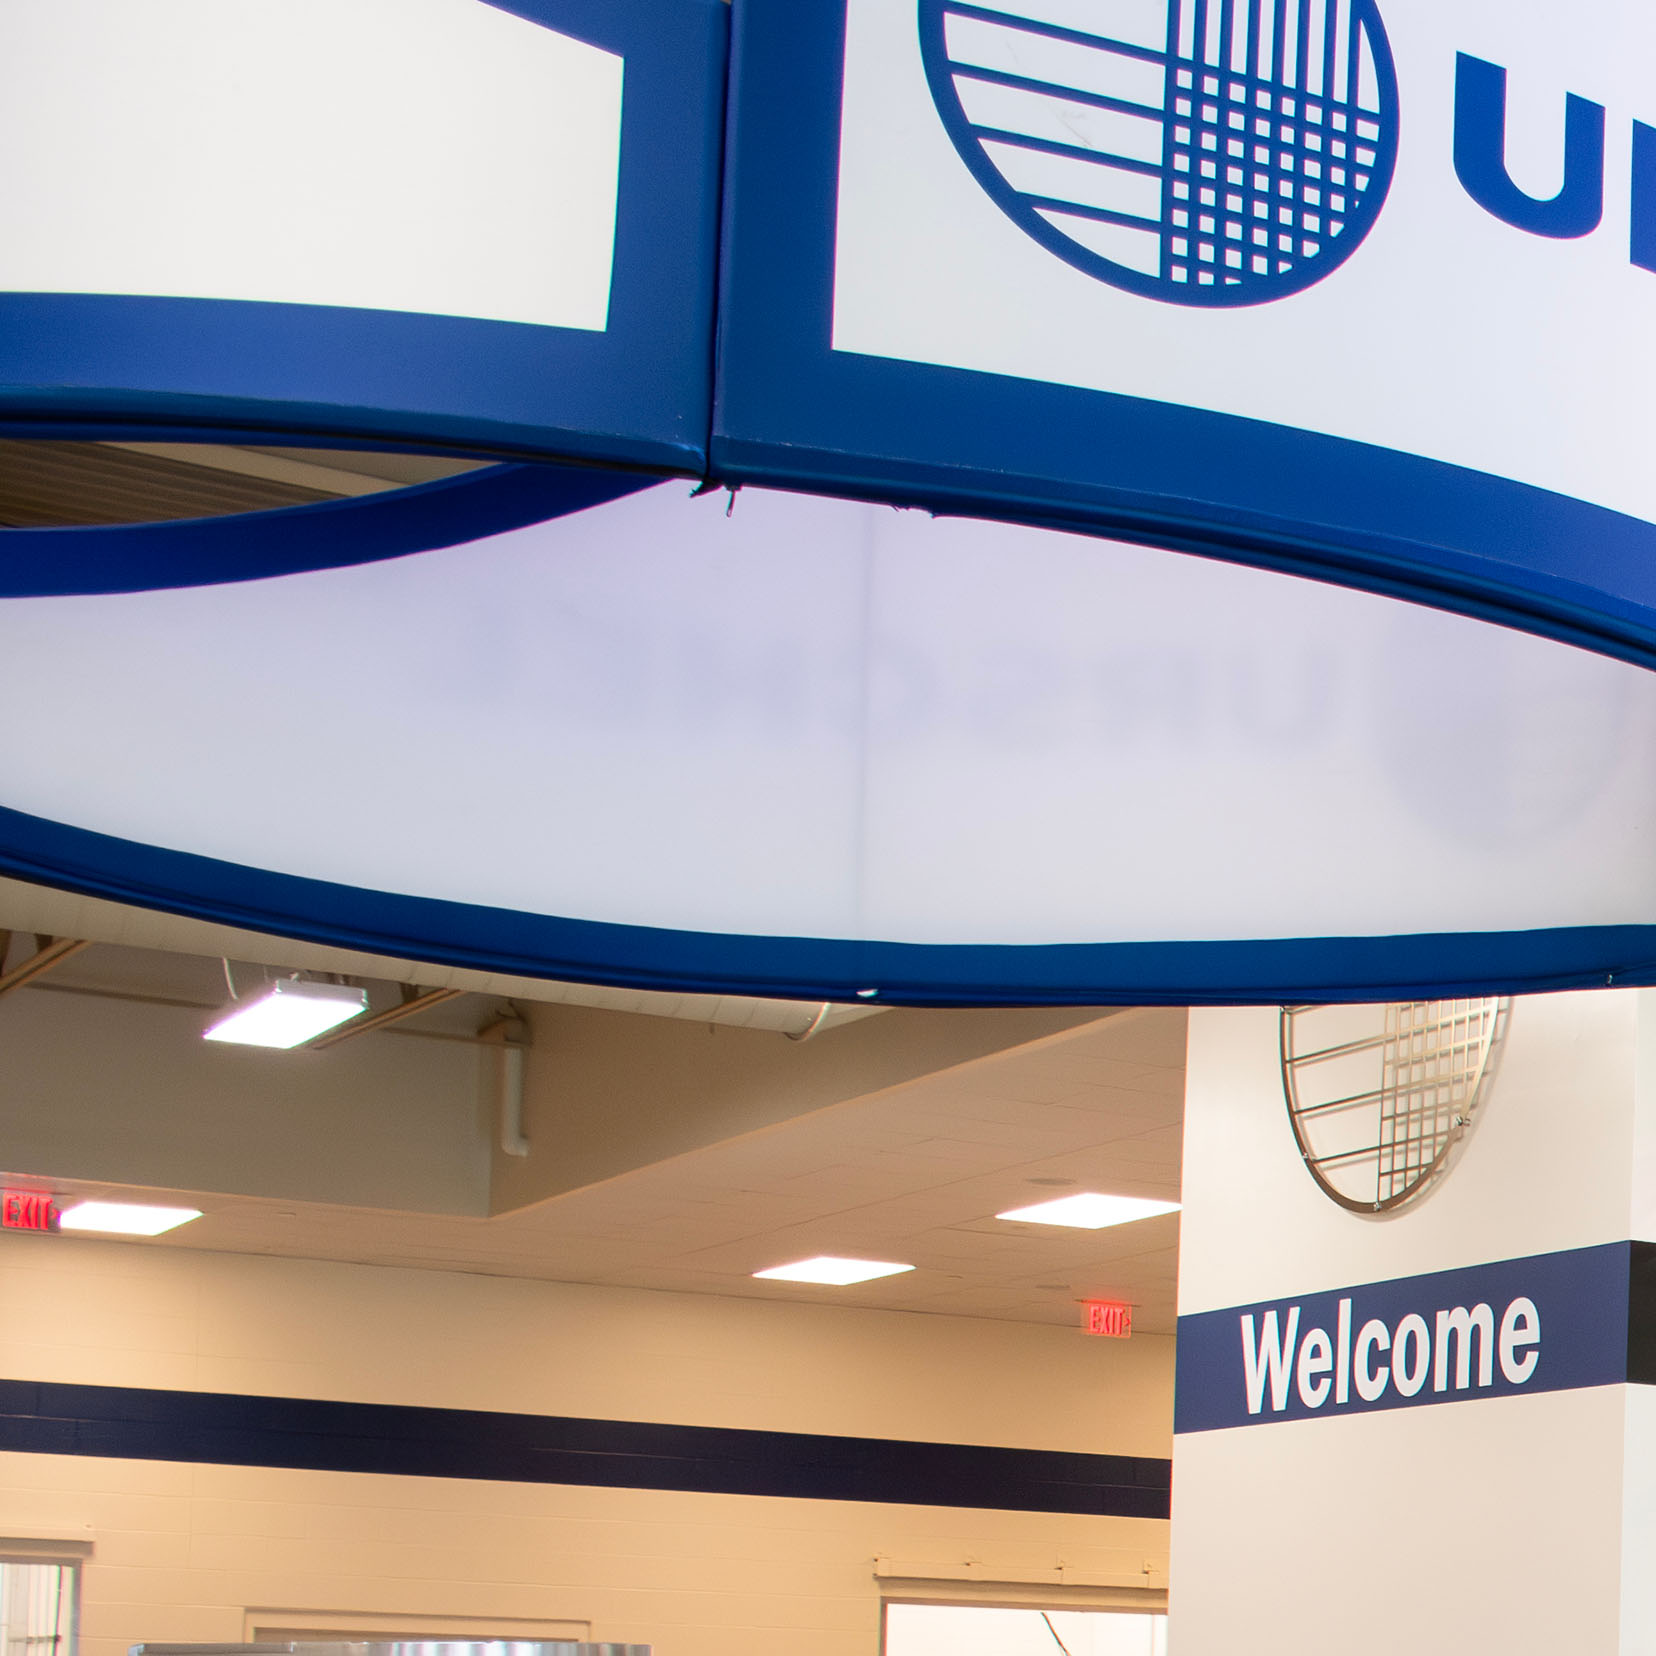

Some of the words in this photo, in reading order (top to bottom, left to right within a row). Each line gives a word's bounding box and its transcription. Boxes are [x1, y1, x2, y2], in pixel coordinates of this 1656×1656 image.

[2, 1193, 52, 1231] EXIT
[1089, 1306, 1125, 1336] EXIT
[1241, 1297, 1542, 1415] Welcome
